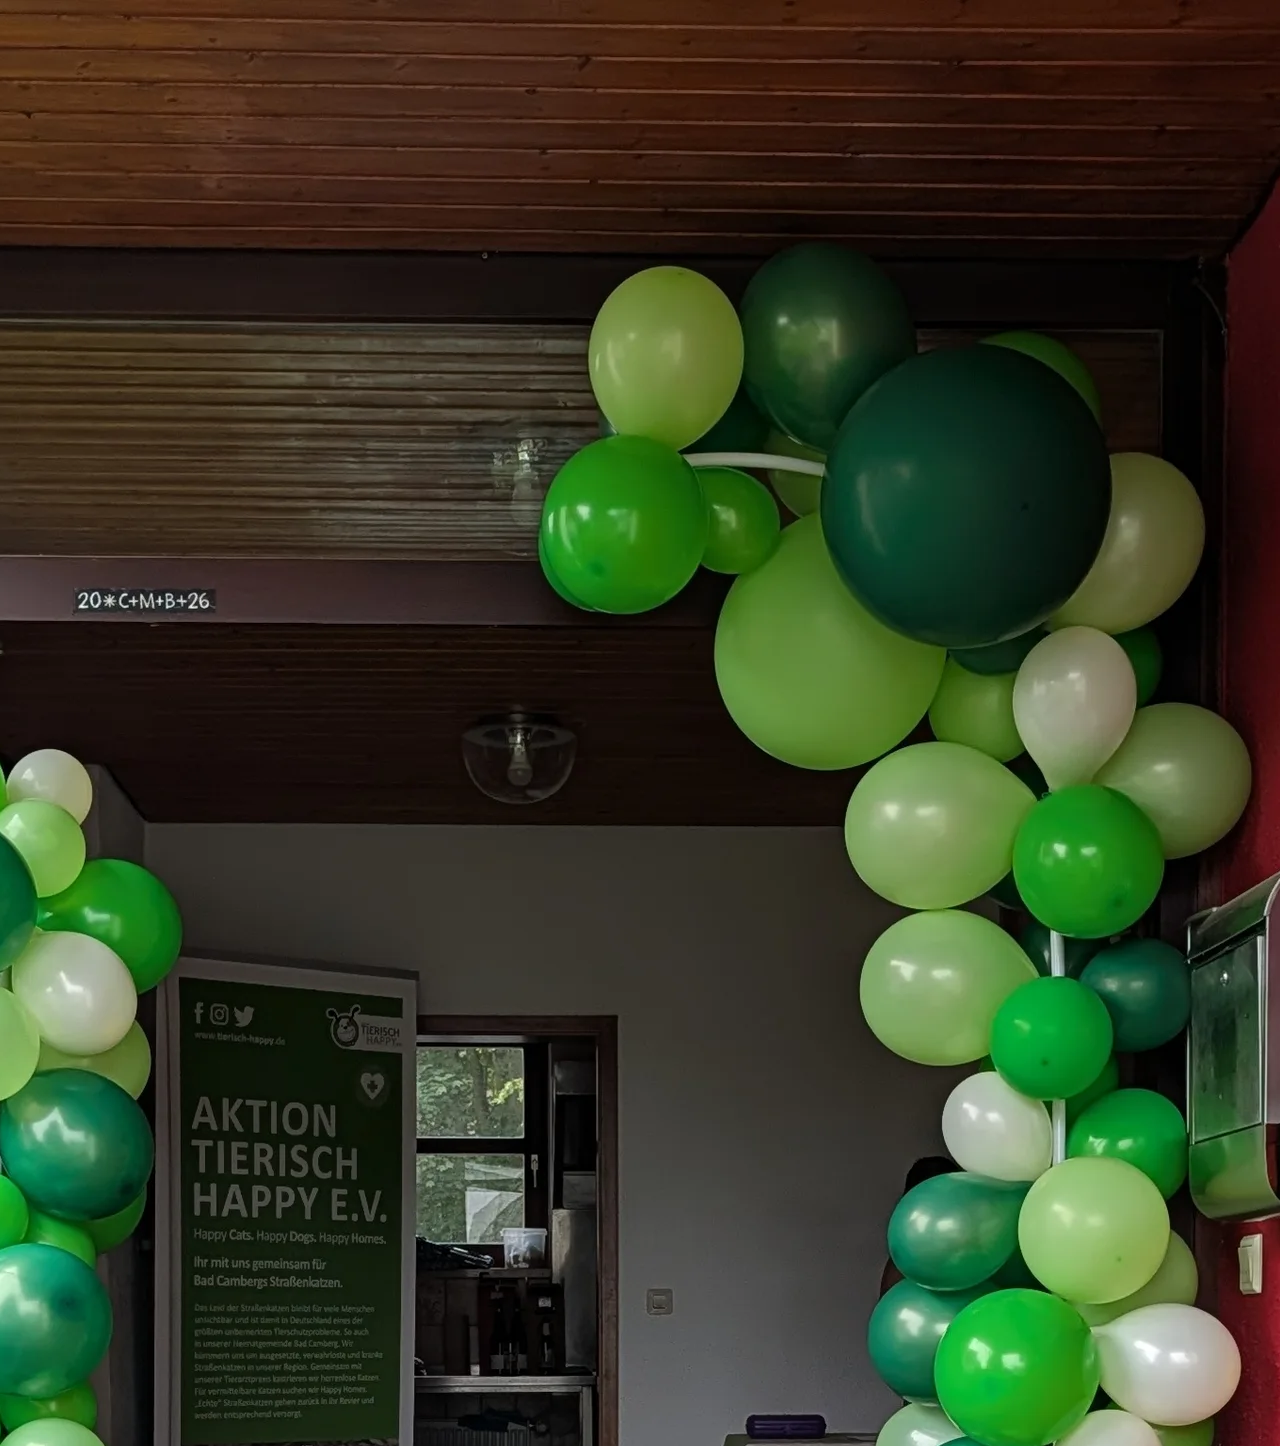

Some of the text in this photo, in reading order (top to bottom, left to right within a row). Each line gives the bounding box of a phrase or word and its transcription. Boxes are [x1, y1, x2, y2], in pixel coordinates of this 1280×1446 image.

[361, 1025, 400, 1036] TIERISCH
[366, 1036, 395, 1046] HAPPY
[191, 1096, 336, 1137] AKTION
[191, 1139, 358, 1180] TIERISCH
[193, 1183, 387, 1223] HAPPY E.V.
[193, 1229, 386, 1245] Happy Cats. Happy Dogs. Happy Homes.
[193, 1256, 326, 1271] Ihr mit uns gemeinsam für
[193, 1275, 343, 1289] Bad Cambergs Straßenkatzen.
[321, 1386, 342, 1394] Happy
